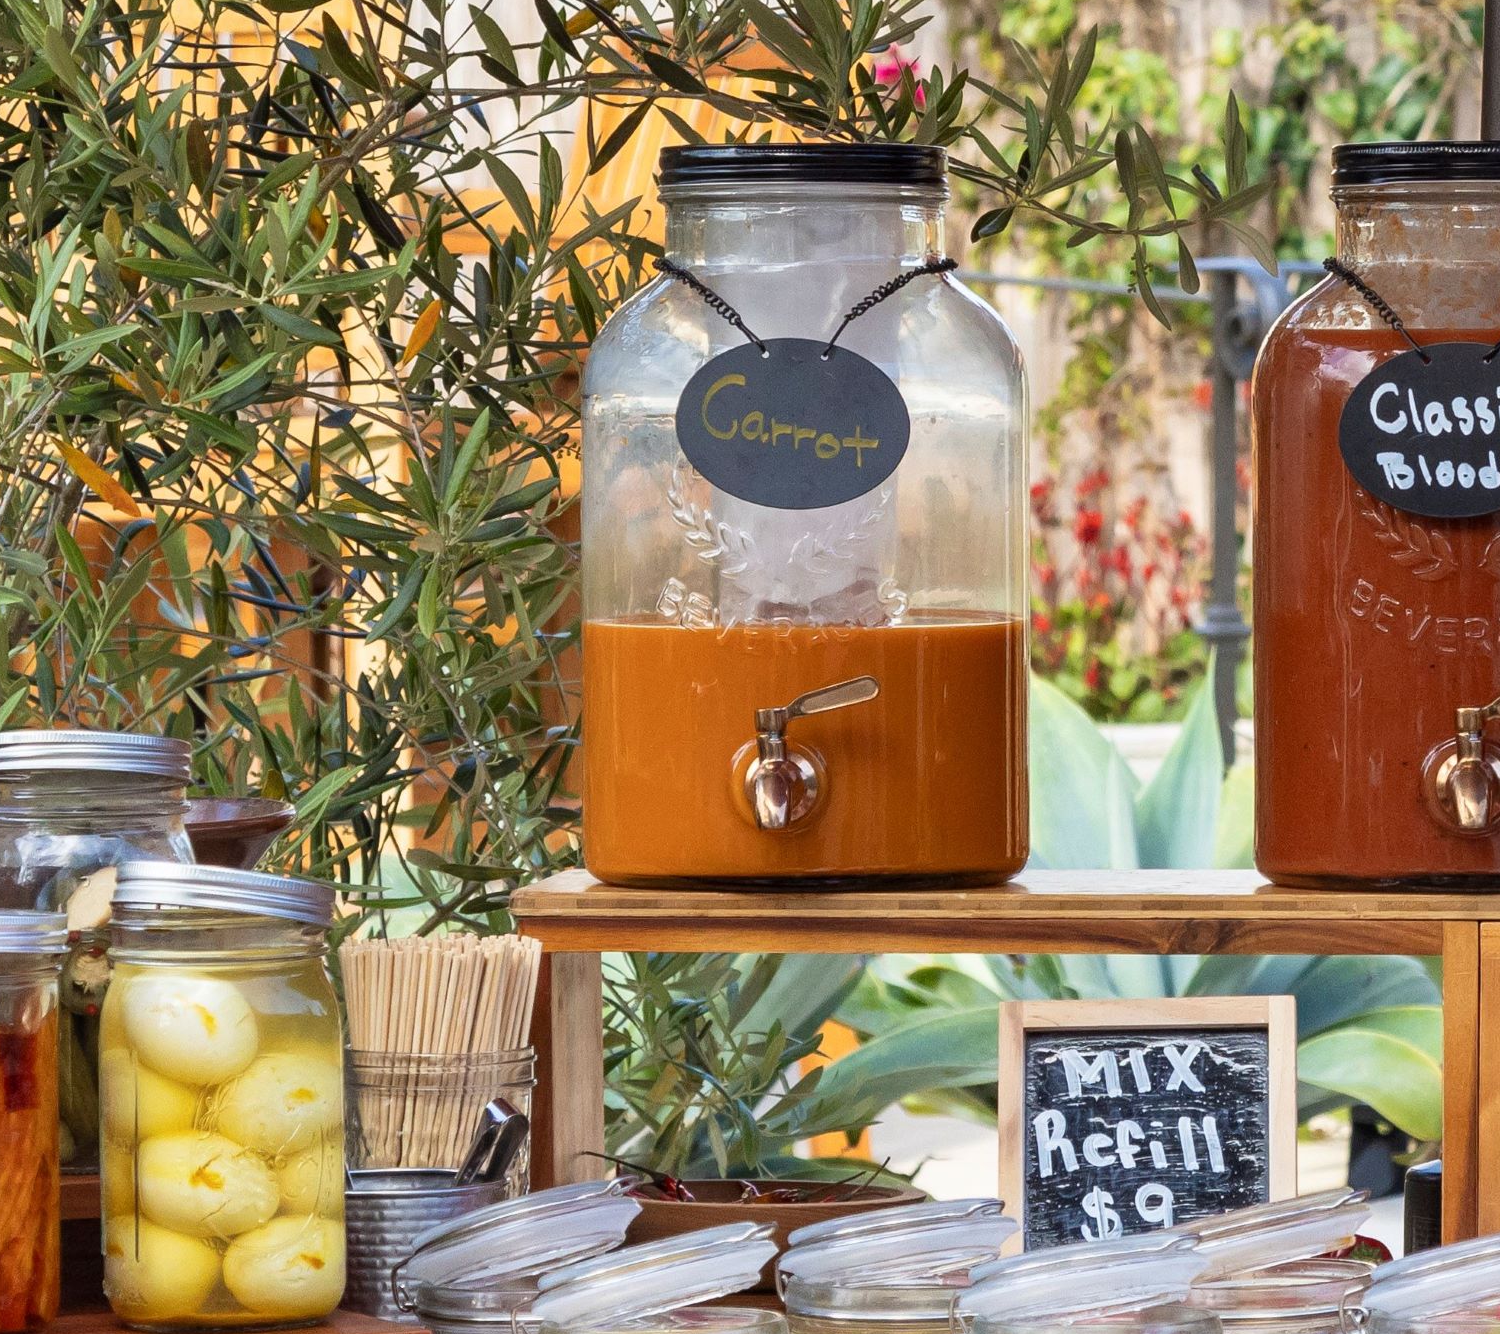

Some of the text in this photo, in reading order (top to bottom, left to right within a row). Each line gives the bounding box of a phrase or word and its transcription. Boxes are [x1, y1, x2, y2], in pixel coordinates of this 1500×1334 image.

[702, 374, 880, 468] Carrot
[1060, 1044, 1206, 1098] MIX
[1033, 1109, 1226, 1179] Refill
